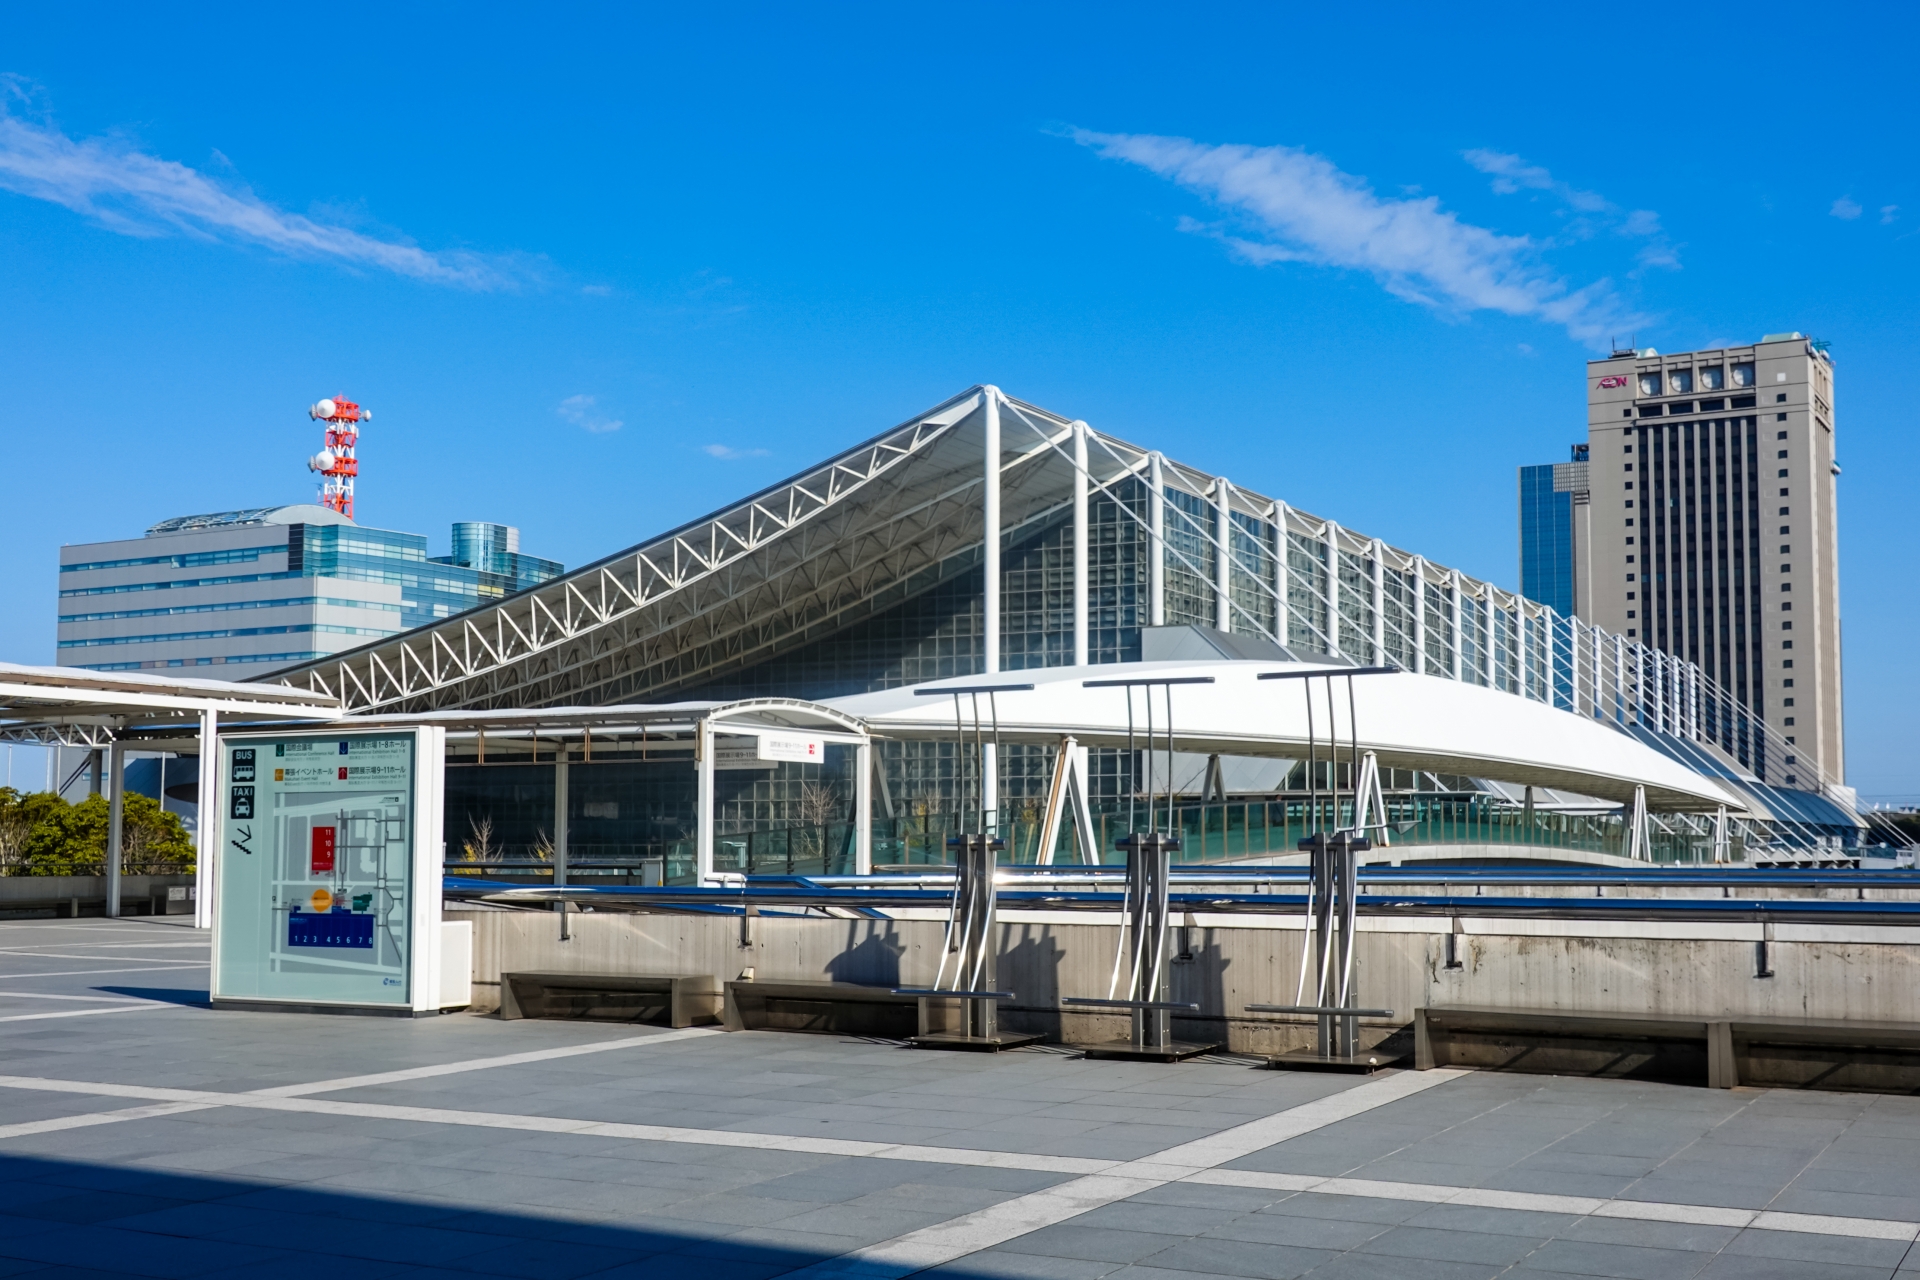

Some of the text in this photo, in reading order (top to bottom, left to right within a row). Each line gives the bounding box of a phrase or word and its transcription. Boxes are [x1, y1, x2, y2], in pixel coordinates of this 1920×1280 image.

[236, 750, 252, 760] BUS
[285, 768, 334, 776] 幕張イベントホール
[233, 787, 253, 796] TAXI
